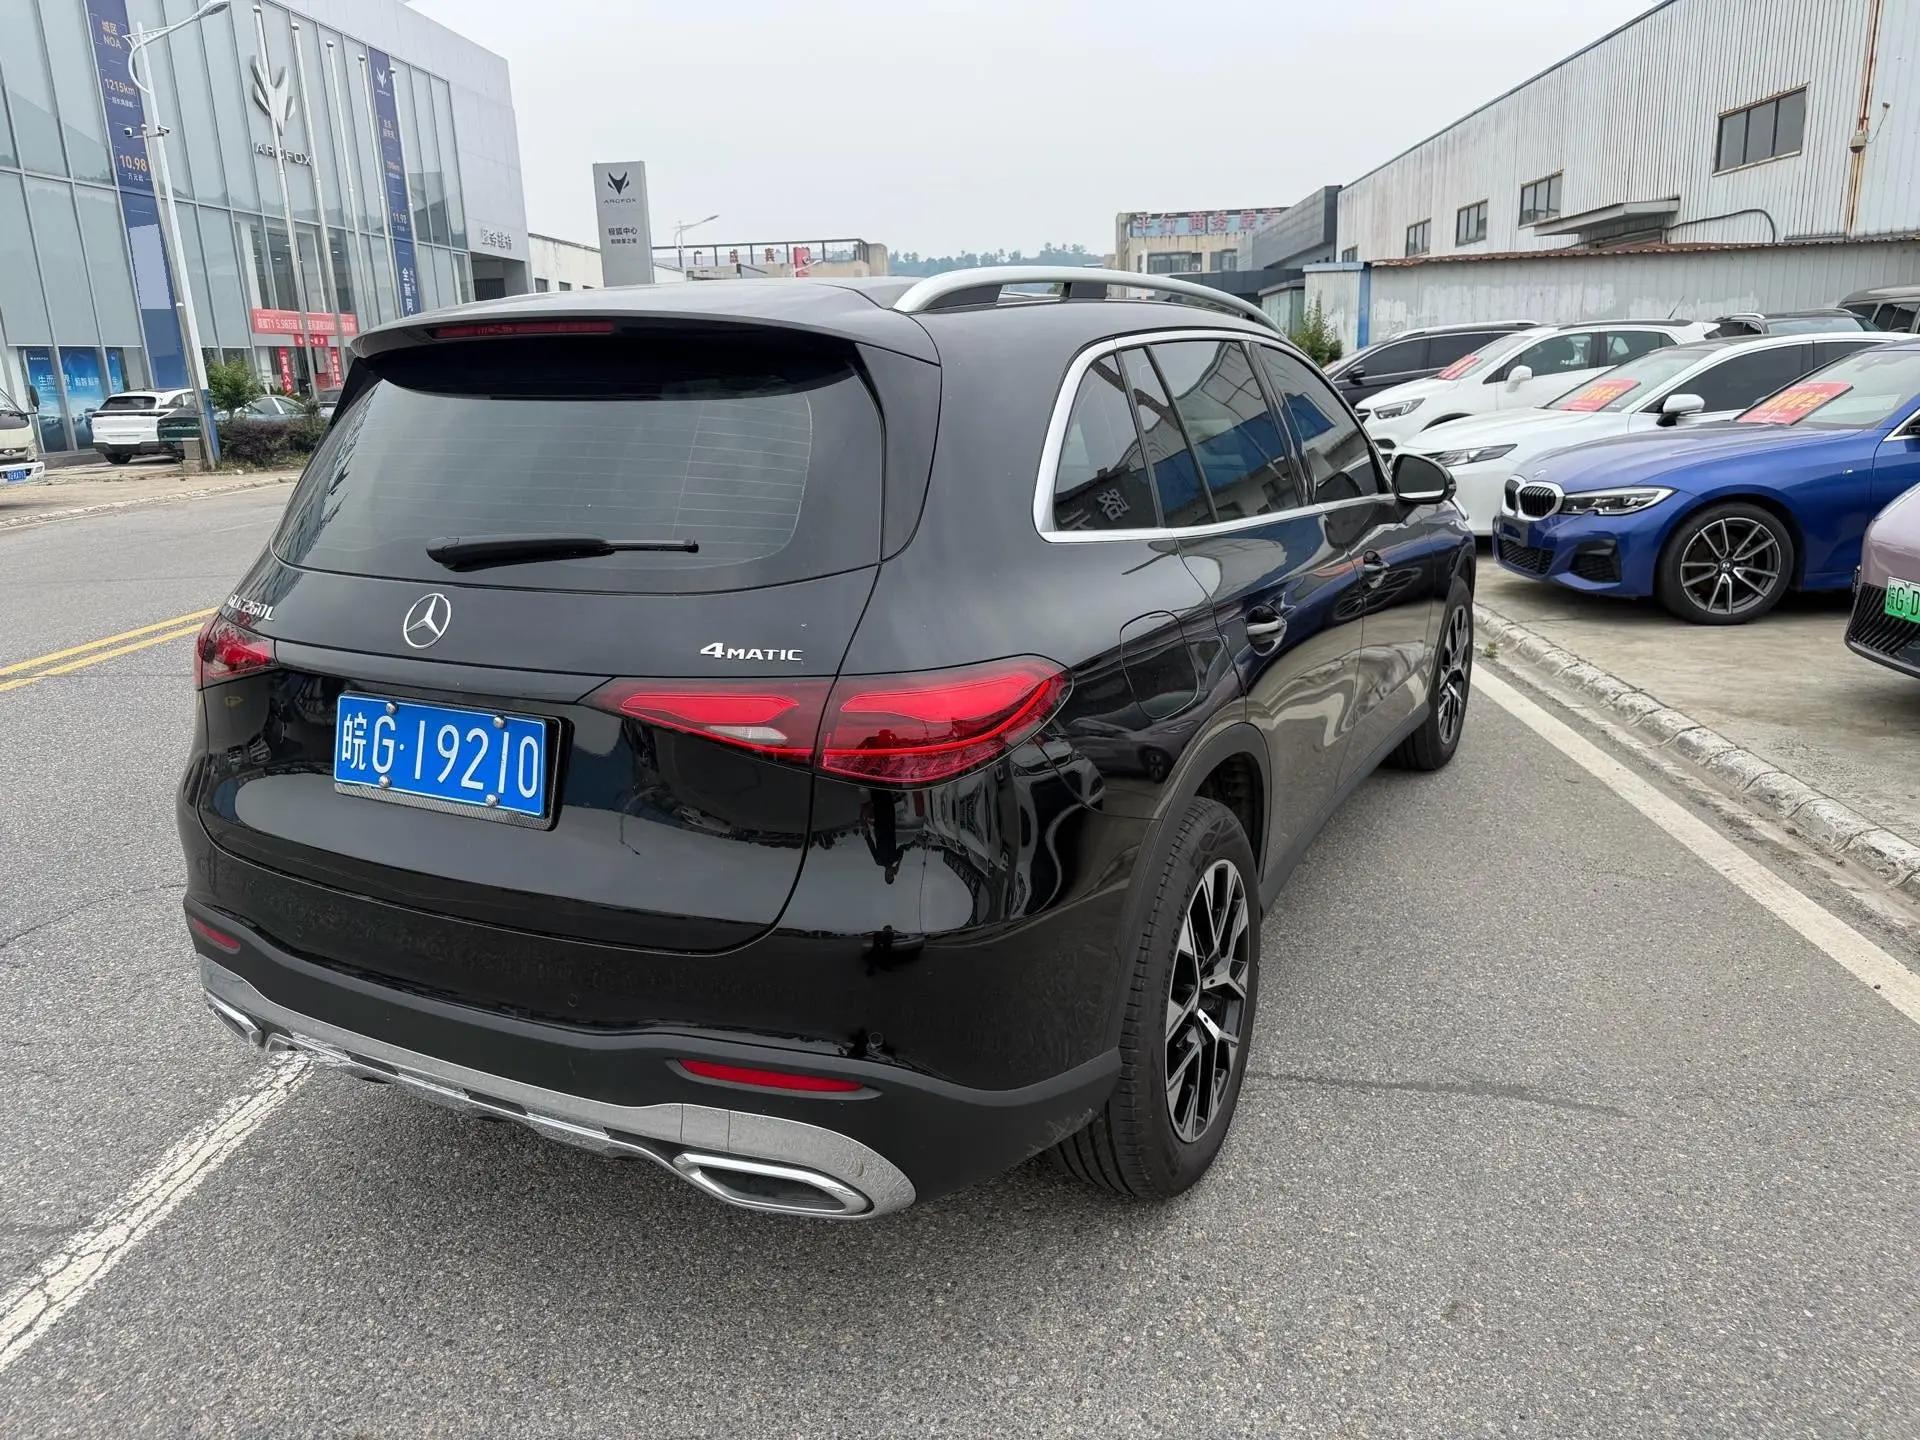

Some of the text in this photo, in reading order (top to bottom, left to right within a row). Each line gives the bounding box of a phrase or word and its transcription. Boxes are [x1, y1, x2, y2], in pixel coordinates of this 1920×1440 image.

[103, 34, 122, 49] NOA
[104, 78, 136, 96] 1215km
[119, 154, 148, 172] 10.98
[700, 642, 804, 661] 4MATIC
